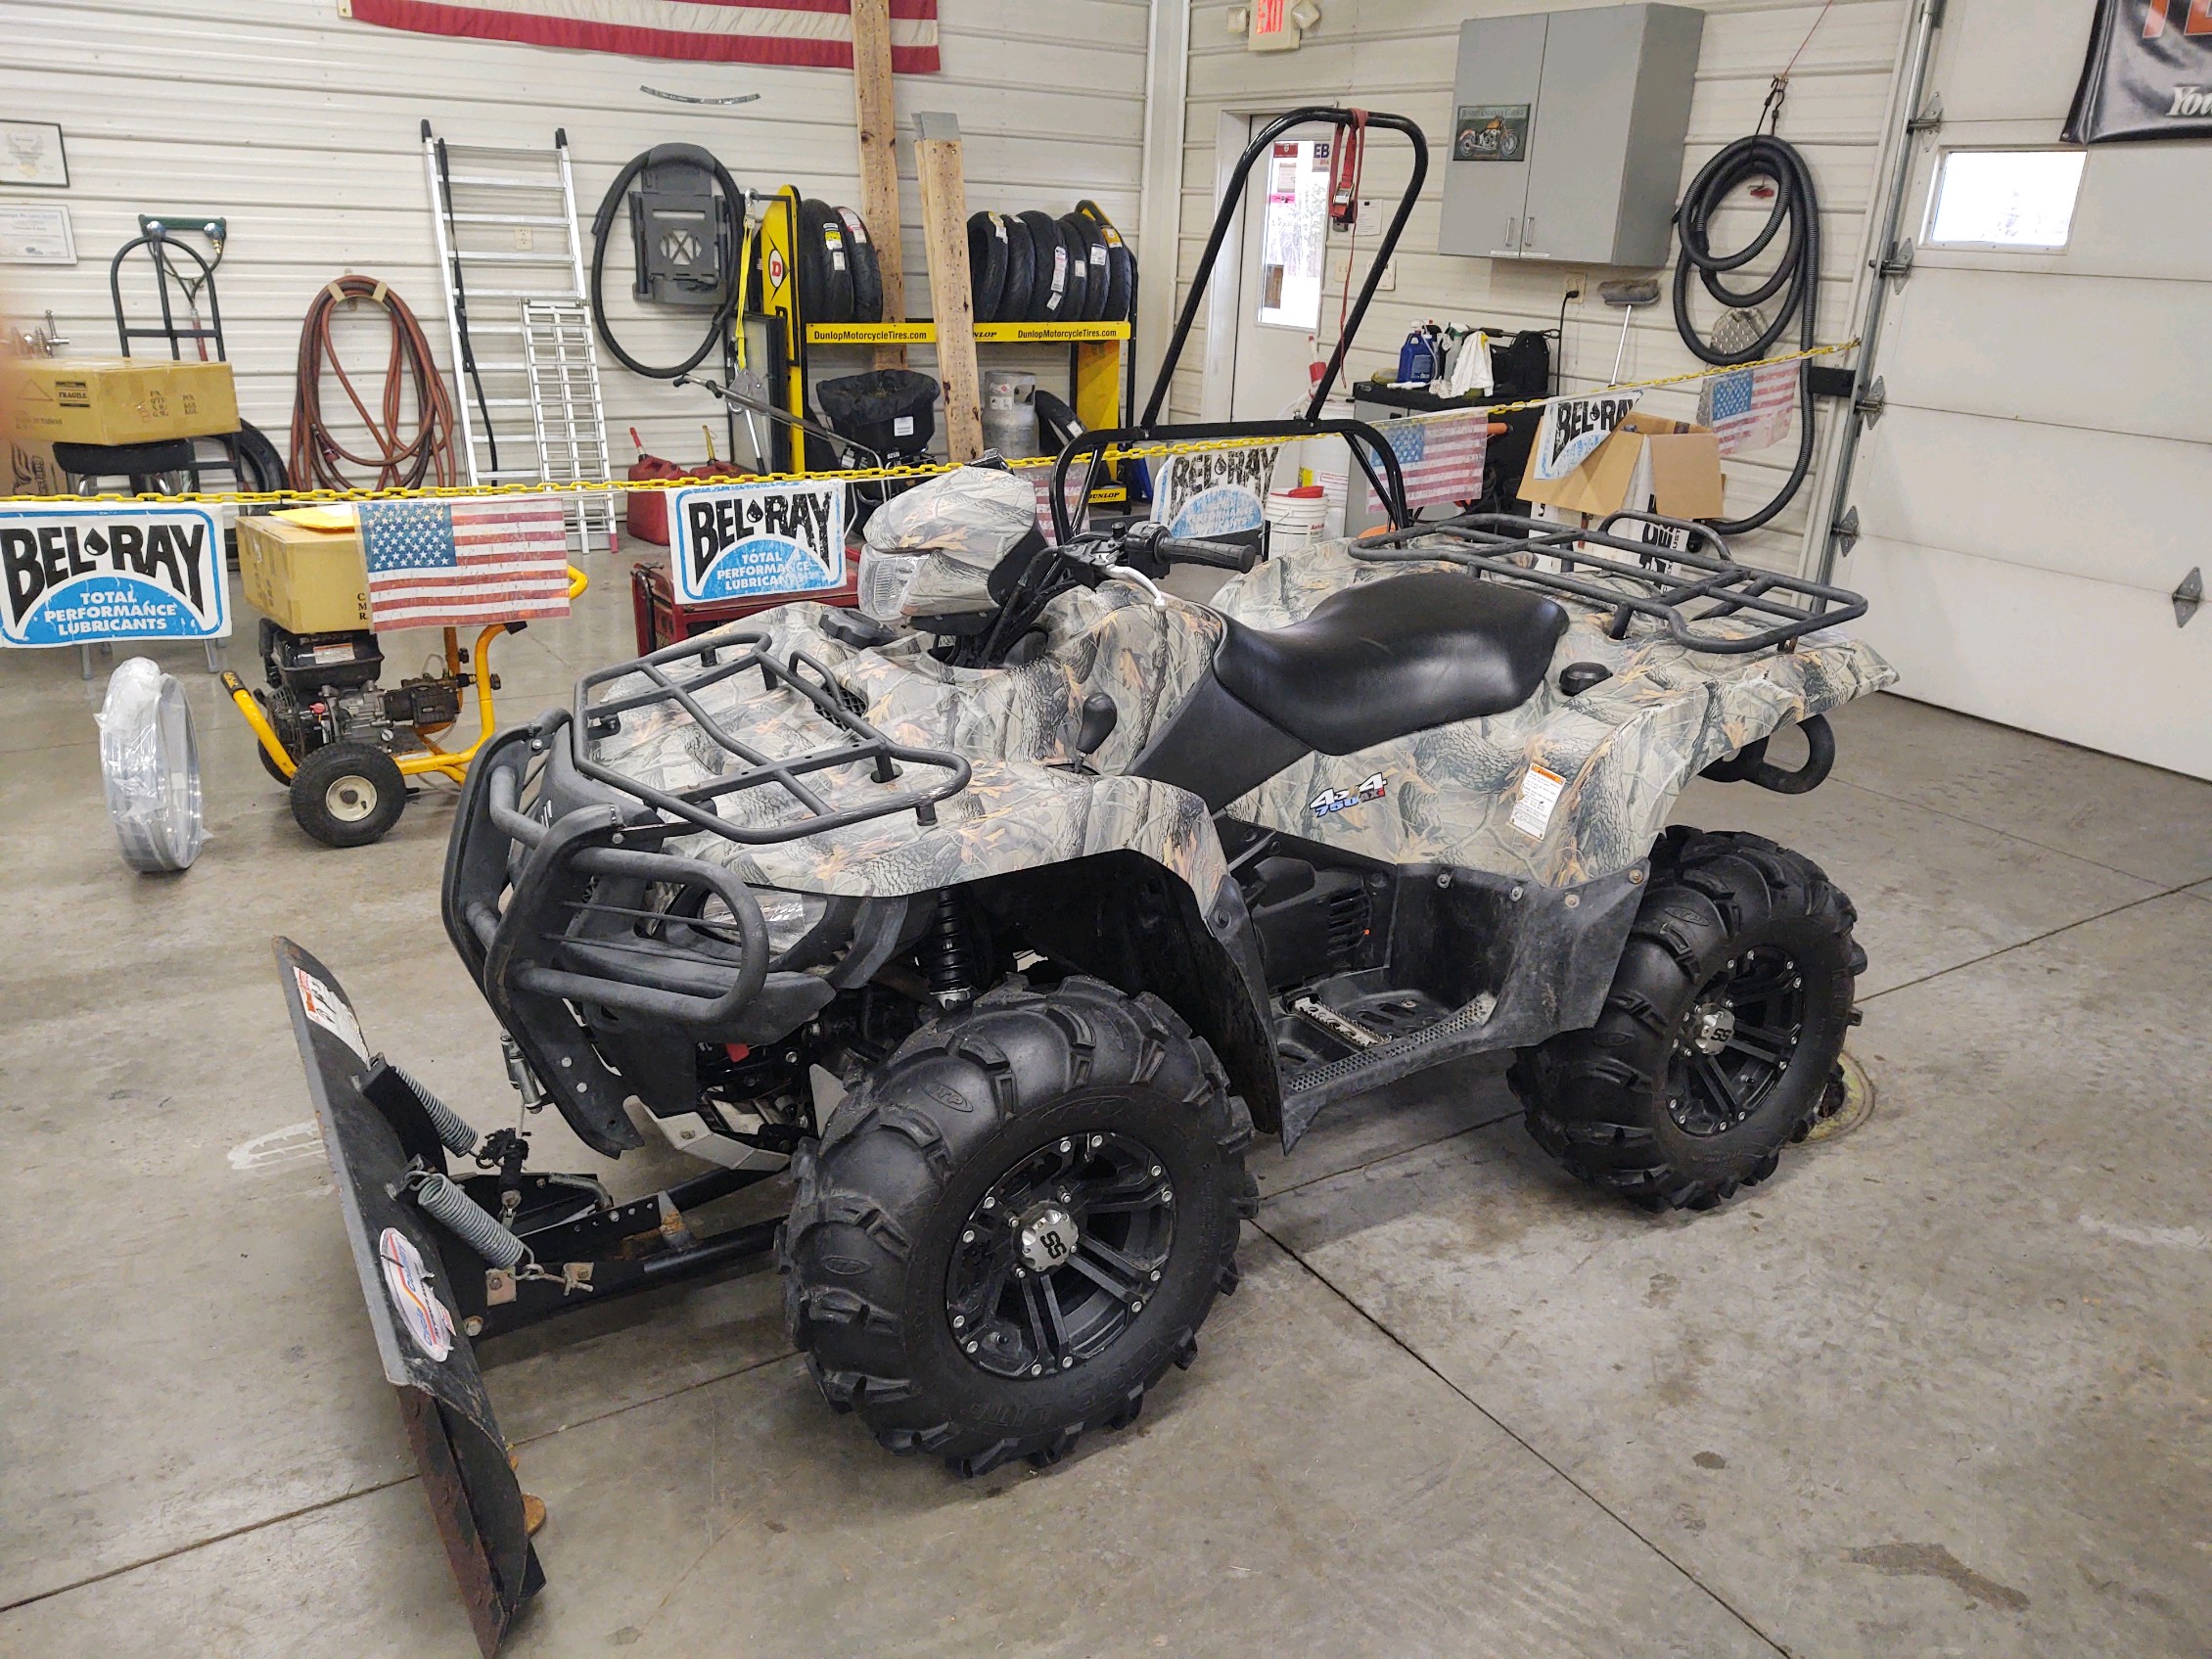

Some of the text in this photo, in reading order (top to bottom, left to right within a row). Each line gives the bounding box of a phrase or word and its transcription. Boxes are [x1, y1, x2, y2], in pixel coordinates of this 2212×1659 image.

[813, 330, 927, 342] DunlopMotorcycleTires.com
[1017, 329, 1117, 340] DunlopMotorcycleTires.com
[1550, 399, 1594, 468] BEL
[688, 490, 833, 586] BEL RAY
[741, 551, 783, 565] TOTAL
[0, 524, 206, 629] BEL RAY
[80, 589, 138, 606] TOTAL
[44, 603, 178, 623] PERFORMANCE
[58, 618, 167, 636] LUBRICANTS
[1711, 1028, 1732, 1042] SS
[1039, 1230, 1068, 1260] SS
